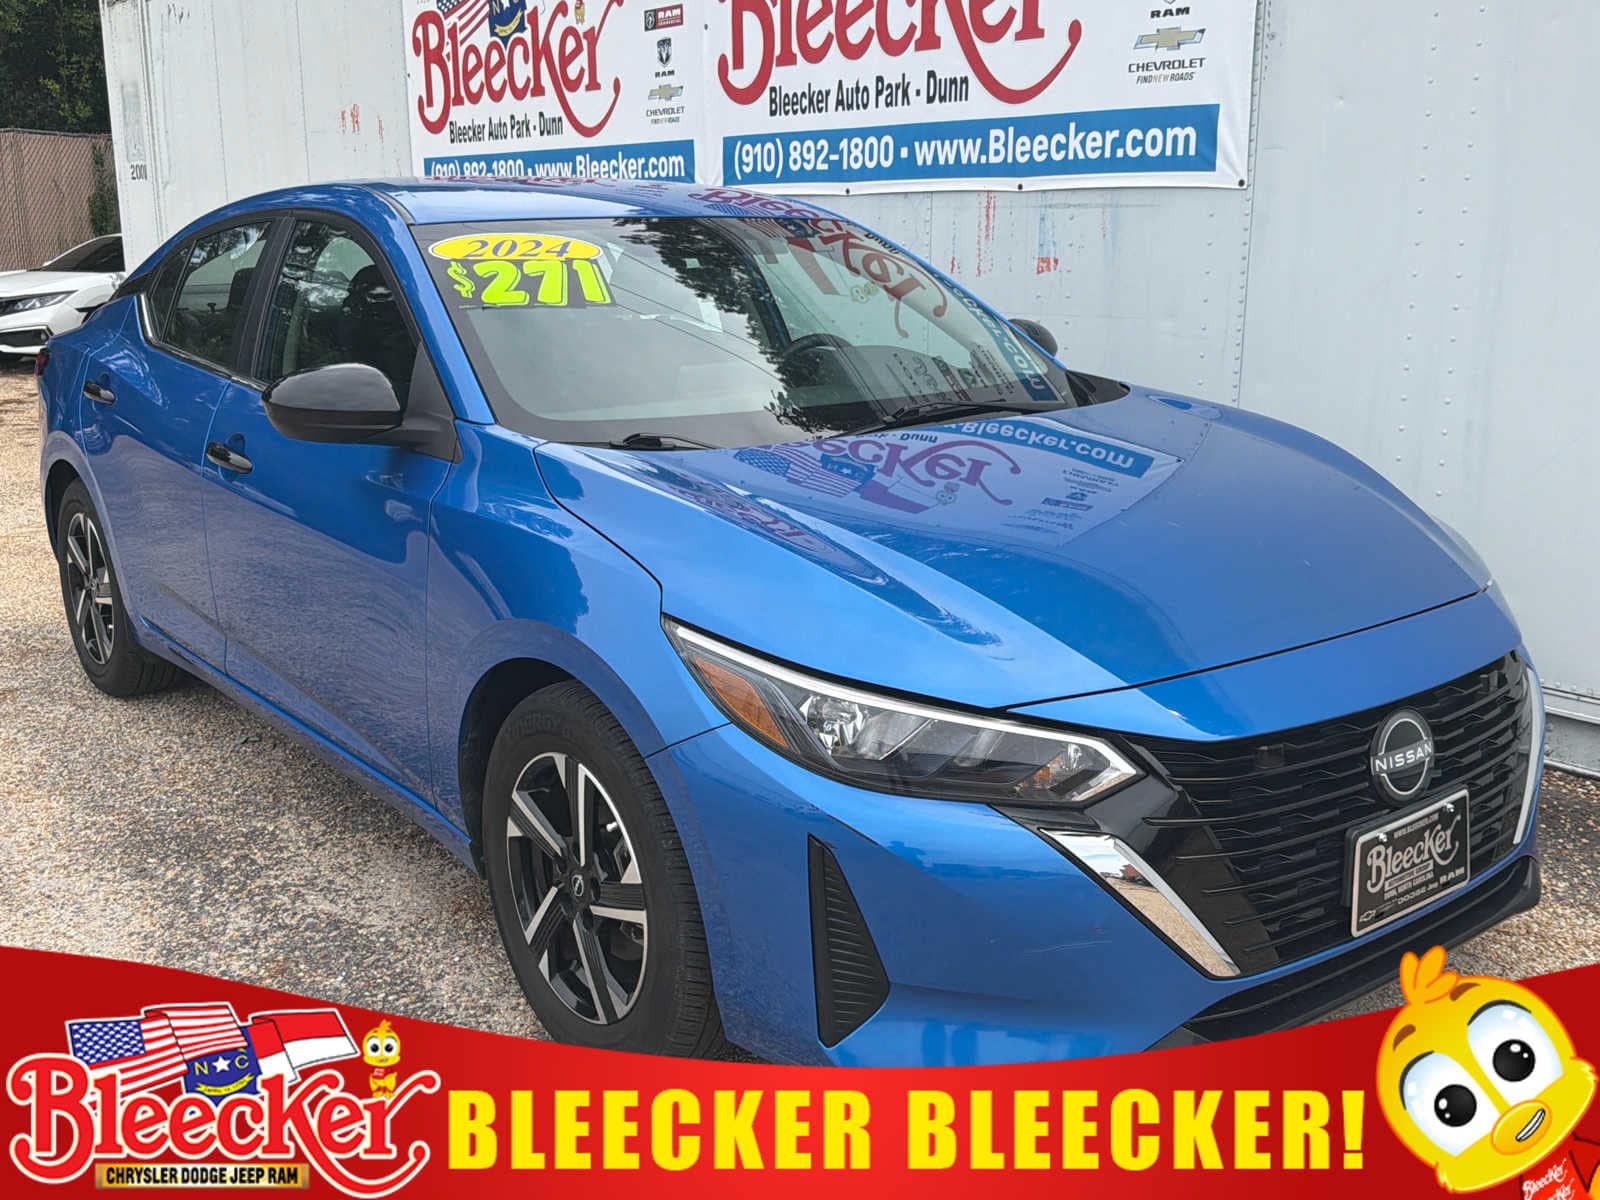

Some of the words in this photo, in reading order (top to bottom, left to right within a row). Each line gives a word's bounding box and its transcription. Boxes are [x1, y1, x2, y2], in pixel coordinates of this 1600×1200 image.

[657, 8, 681, 19] RAM
[1150, 7, 1190, 18] RAM
[412, 0, 624, 138] Bleecker
[1128, 57, 1206, 73] CHEVROLET
[769, 82, 831, 117] Bleecker
[835, 79, 870, 112] Auto
[875, 73, 911, 107] Park
[926, 69, 969, 104] Dunn
[449, 118, 486, 145] Bleecker
[488, 117, 508, 140] Auto
[510, 113, 532, 139] Park
[539, 111, 563, 137] Dunn
[535, 151, 685, 178] www.Bleecker.com
[734, 138, 783, 181] (910)
[788, 134, 894, 172] 892-1800
[914, 122, 1198, 167] www.Bleecker.com
[463, 240, 570, 257] 2024
[447, 260, 612, 306] $271
[1375, 742, 1433, 772] NISSAN
[1367, 814, 1461, 894] Bleecker
